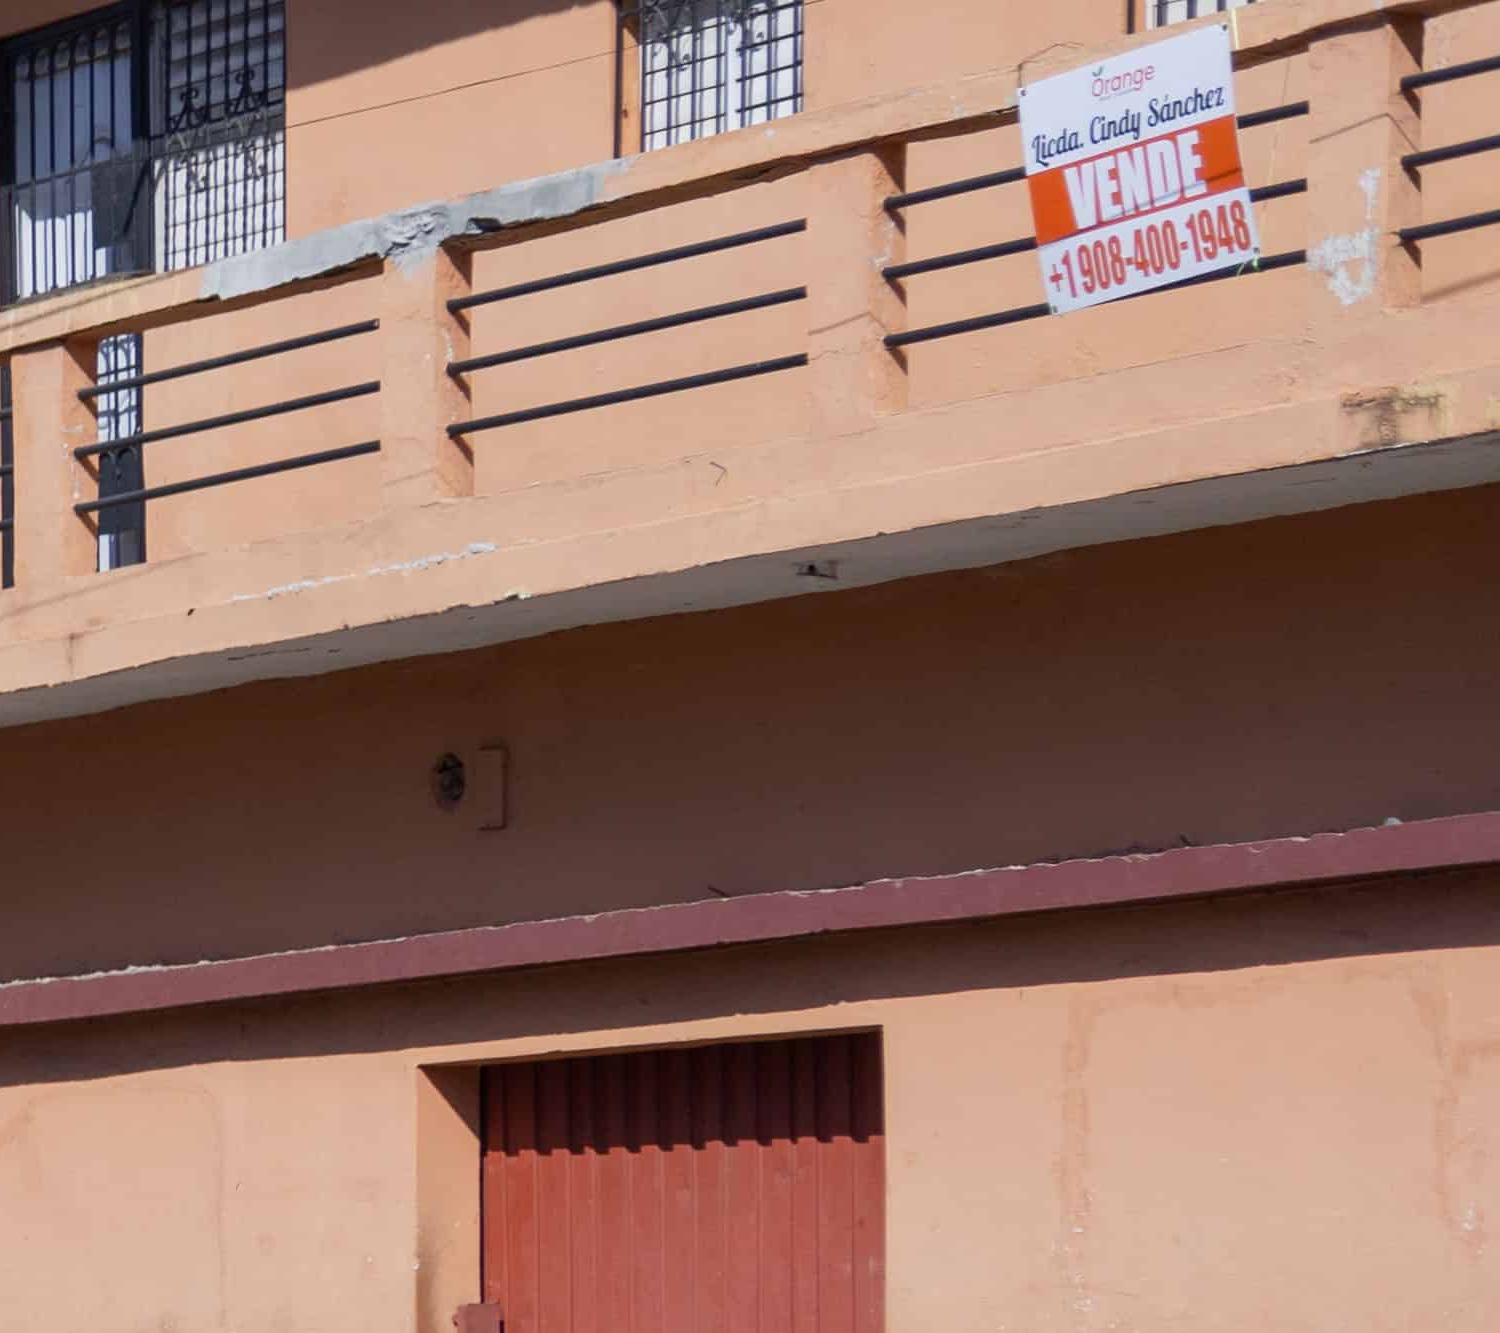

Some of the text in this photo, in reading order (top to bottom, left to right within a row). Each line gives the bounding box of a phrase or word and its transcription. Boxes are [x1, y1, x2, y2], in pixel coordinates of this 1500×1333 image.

[1091, 64, 1156, 98] Orange
[1032, 85, 1226, 167] Licda. Cindy Sánchez
[1062, 130, 1208, 232] VENDE
